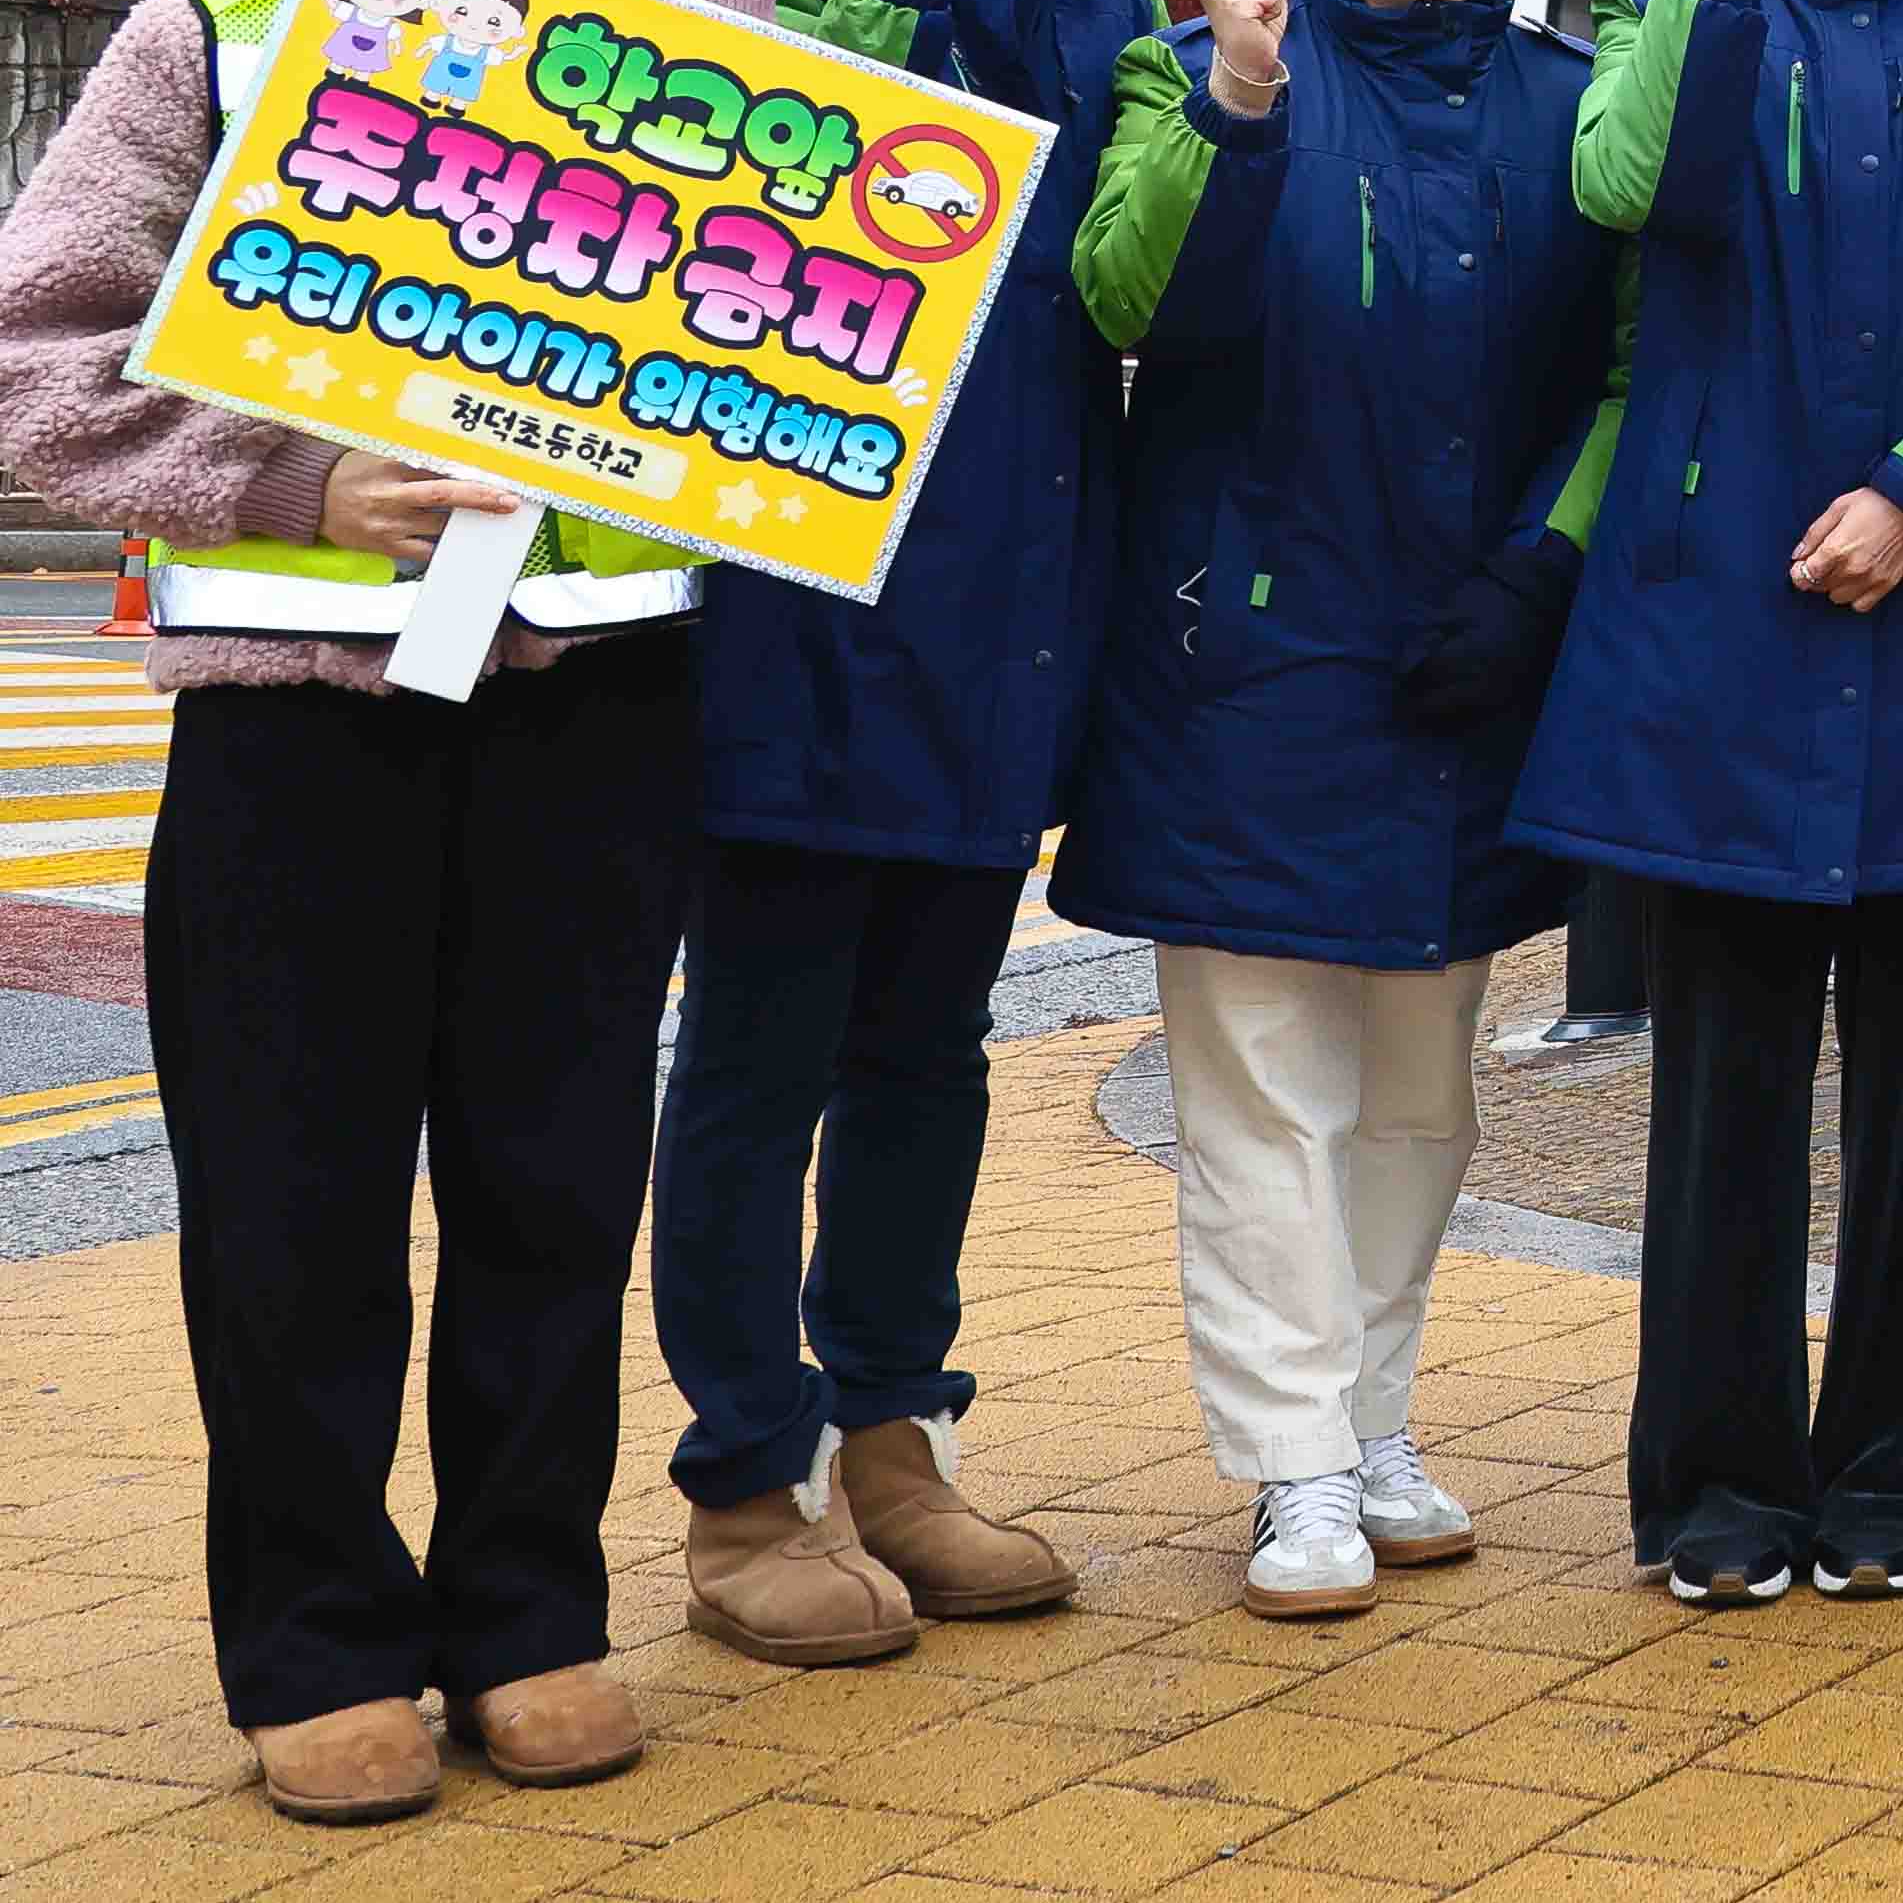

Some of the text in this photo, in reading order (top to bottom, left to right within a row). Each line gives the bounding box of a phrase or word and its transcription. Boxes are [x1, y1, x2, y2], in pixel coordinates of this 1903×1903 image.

[278, 81, 924, 386] 주정차 금지
[526, 9, 864, 218] 학교앞
[209, 218, 905, 497] 우리 아이가 위험해요
[451, 393, 642, 479] 청덕초등학교
